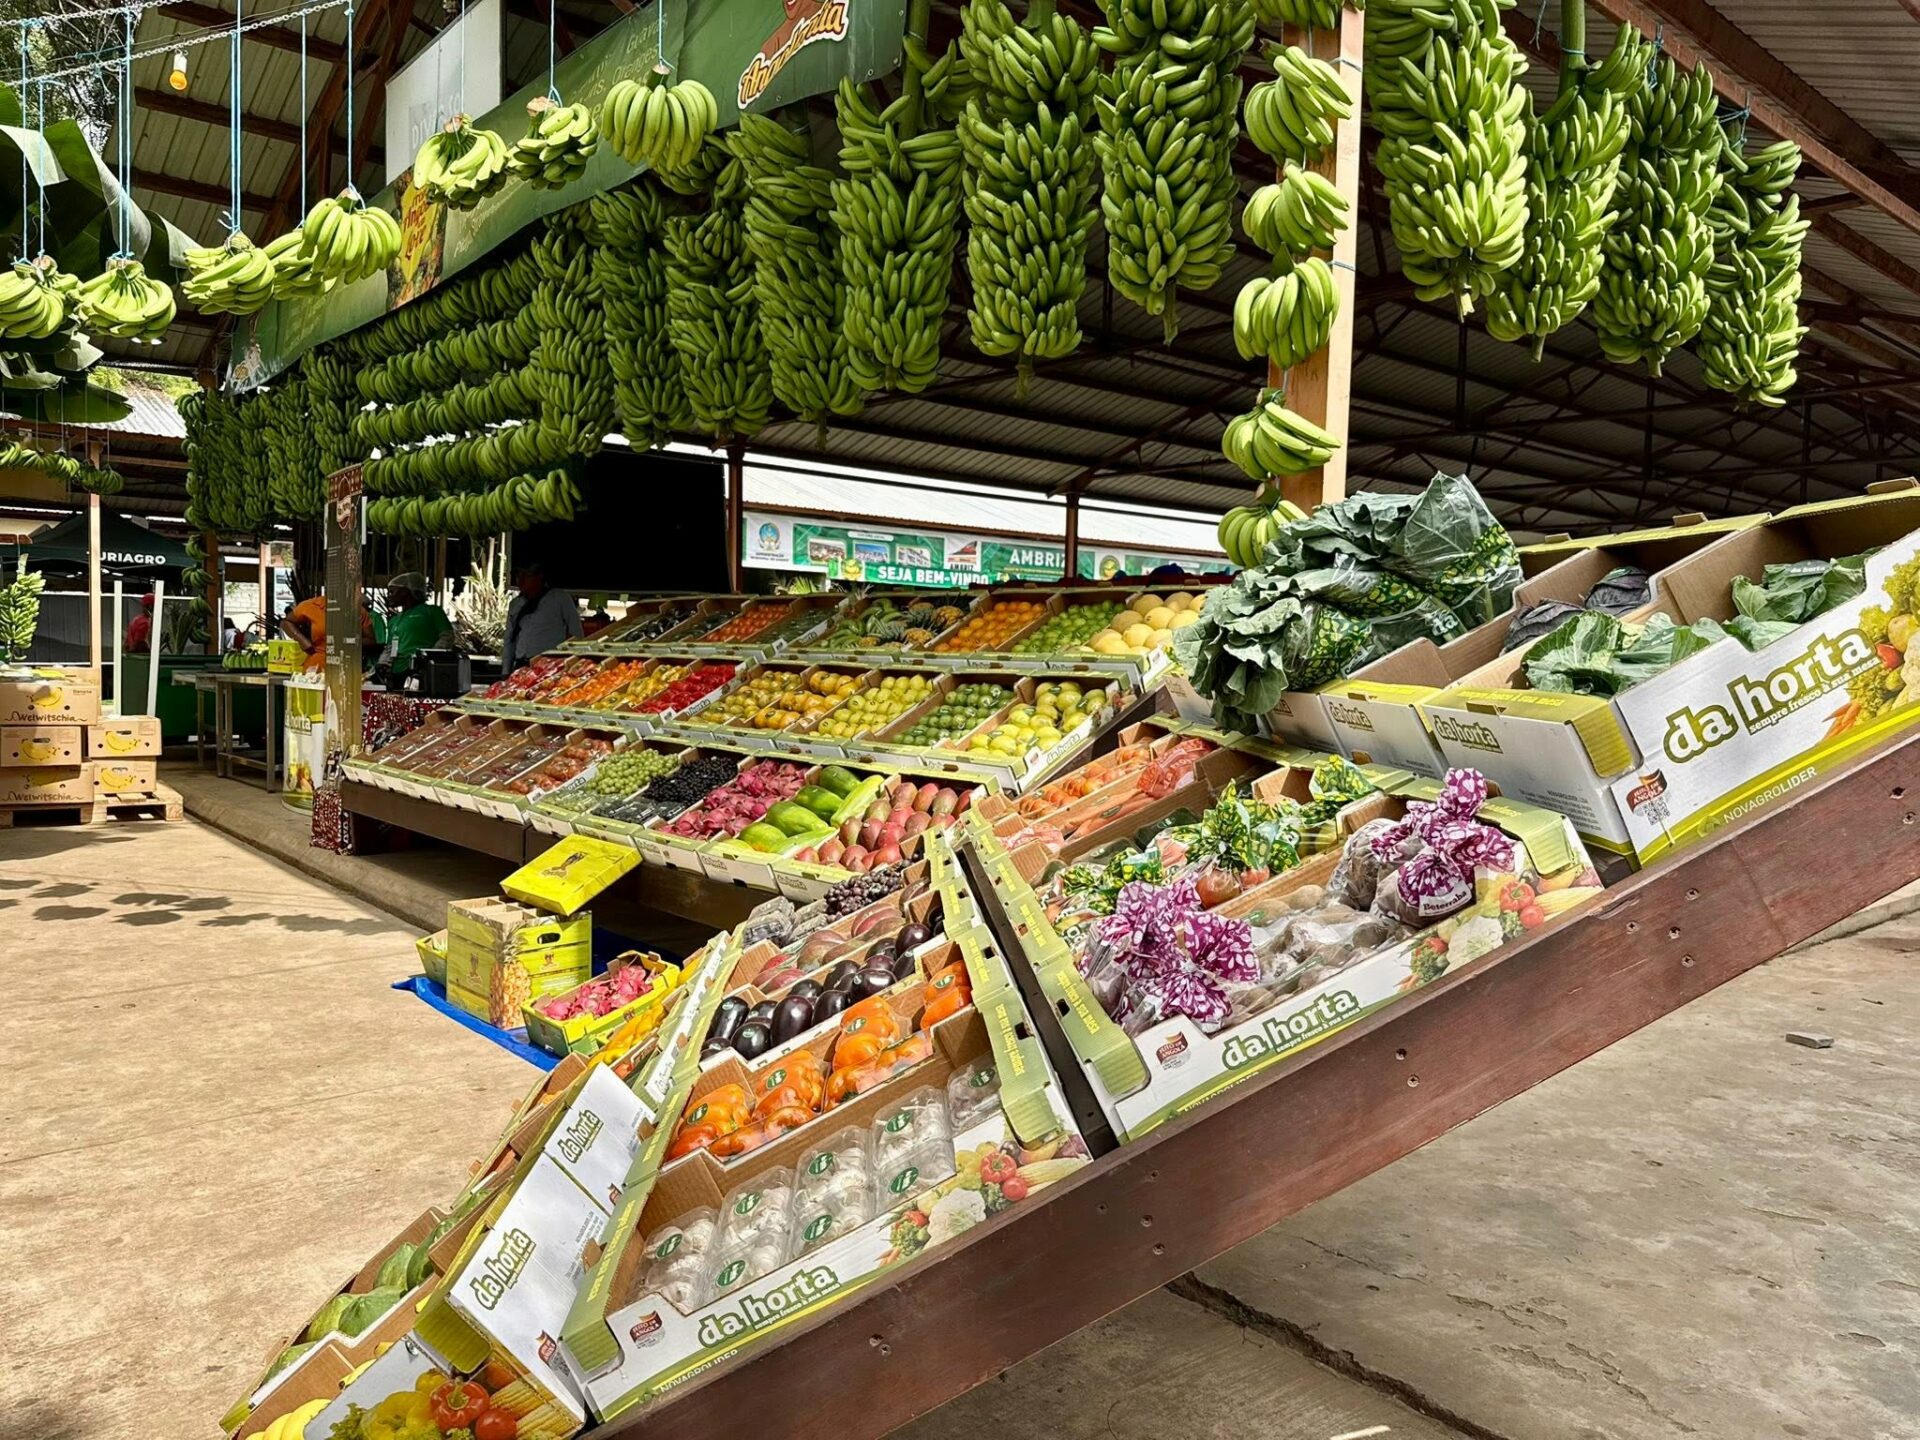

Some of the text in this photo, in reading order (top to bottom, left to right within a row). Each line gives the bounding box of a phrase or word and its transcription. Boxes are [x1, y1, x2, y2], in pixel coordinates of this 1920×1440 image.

[87, 551, 166, 565] URIAGRO
[878, 567, 989, 586] SEJA BEM-VINDO
[1431, 614, 1459, 637] da
[1664, 632, 1875, 762] da horta
[1749, 705, 1789, 732] sempre
[1851, 657, 1880, 679] mesa
[11, 710, 78, 723] Welwitschia
[1433, 715, 1457, 741] da
[1454, 718, 1501, 751] horta
[8, 791, 73, 801] Welwitschia
[1722, 766, 1818, 825] NOVAGROLIDER
[1423, 889, 1467, 911] Beterraba
[1223, 991, 1358, 1069] da horta
[557, 1139, 580, 1164] da
[571, 1109, 602, 1149] horta
[470, 1277, 503, 1311] da
[488, 1228, 533, 1287] horta
[698, 1312, 743, 1348] da
[739, 1266, 837, 1330] horta
[635, 1323, 660, 1336] ANGOLA
